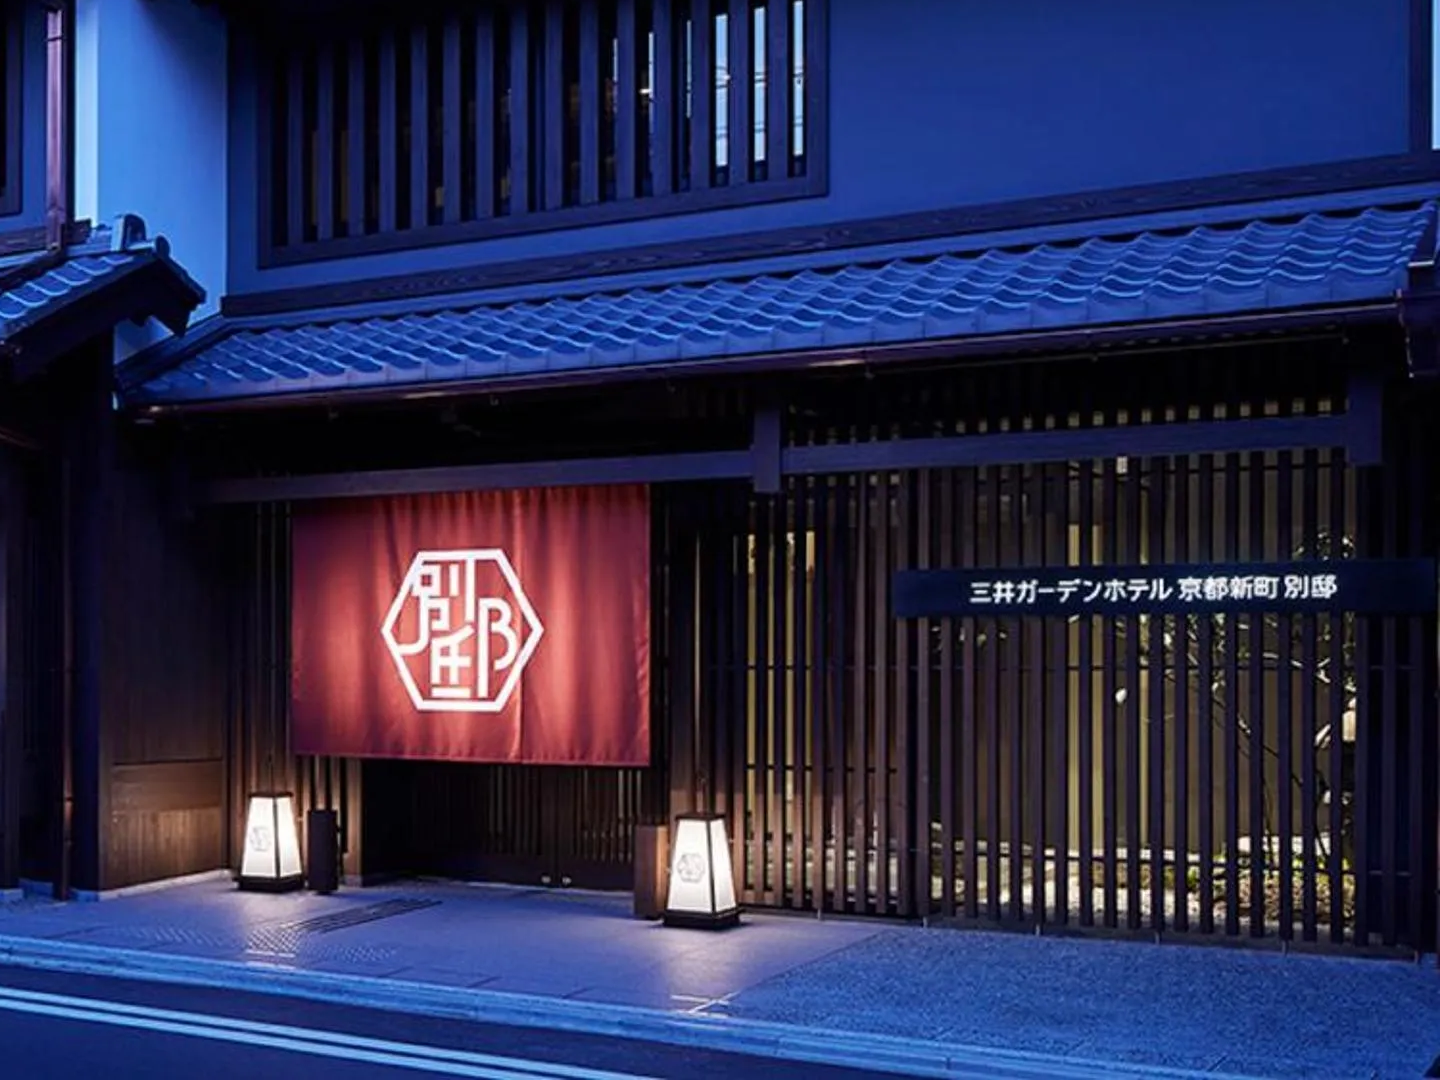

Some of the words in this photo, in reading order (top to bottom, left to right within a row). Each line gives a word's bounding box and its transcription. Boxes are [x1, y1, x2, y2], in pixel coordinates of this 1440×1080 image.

[970, 578, 1173, 603] 三井ガーデンホテル
[1177, 576, 1279, 601] 京都新町
[1283, 574, 1337, 600] 別邸
